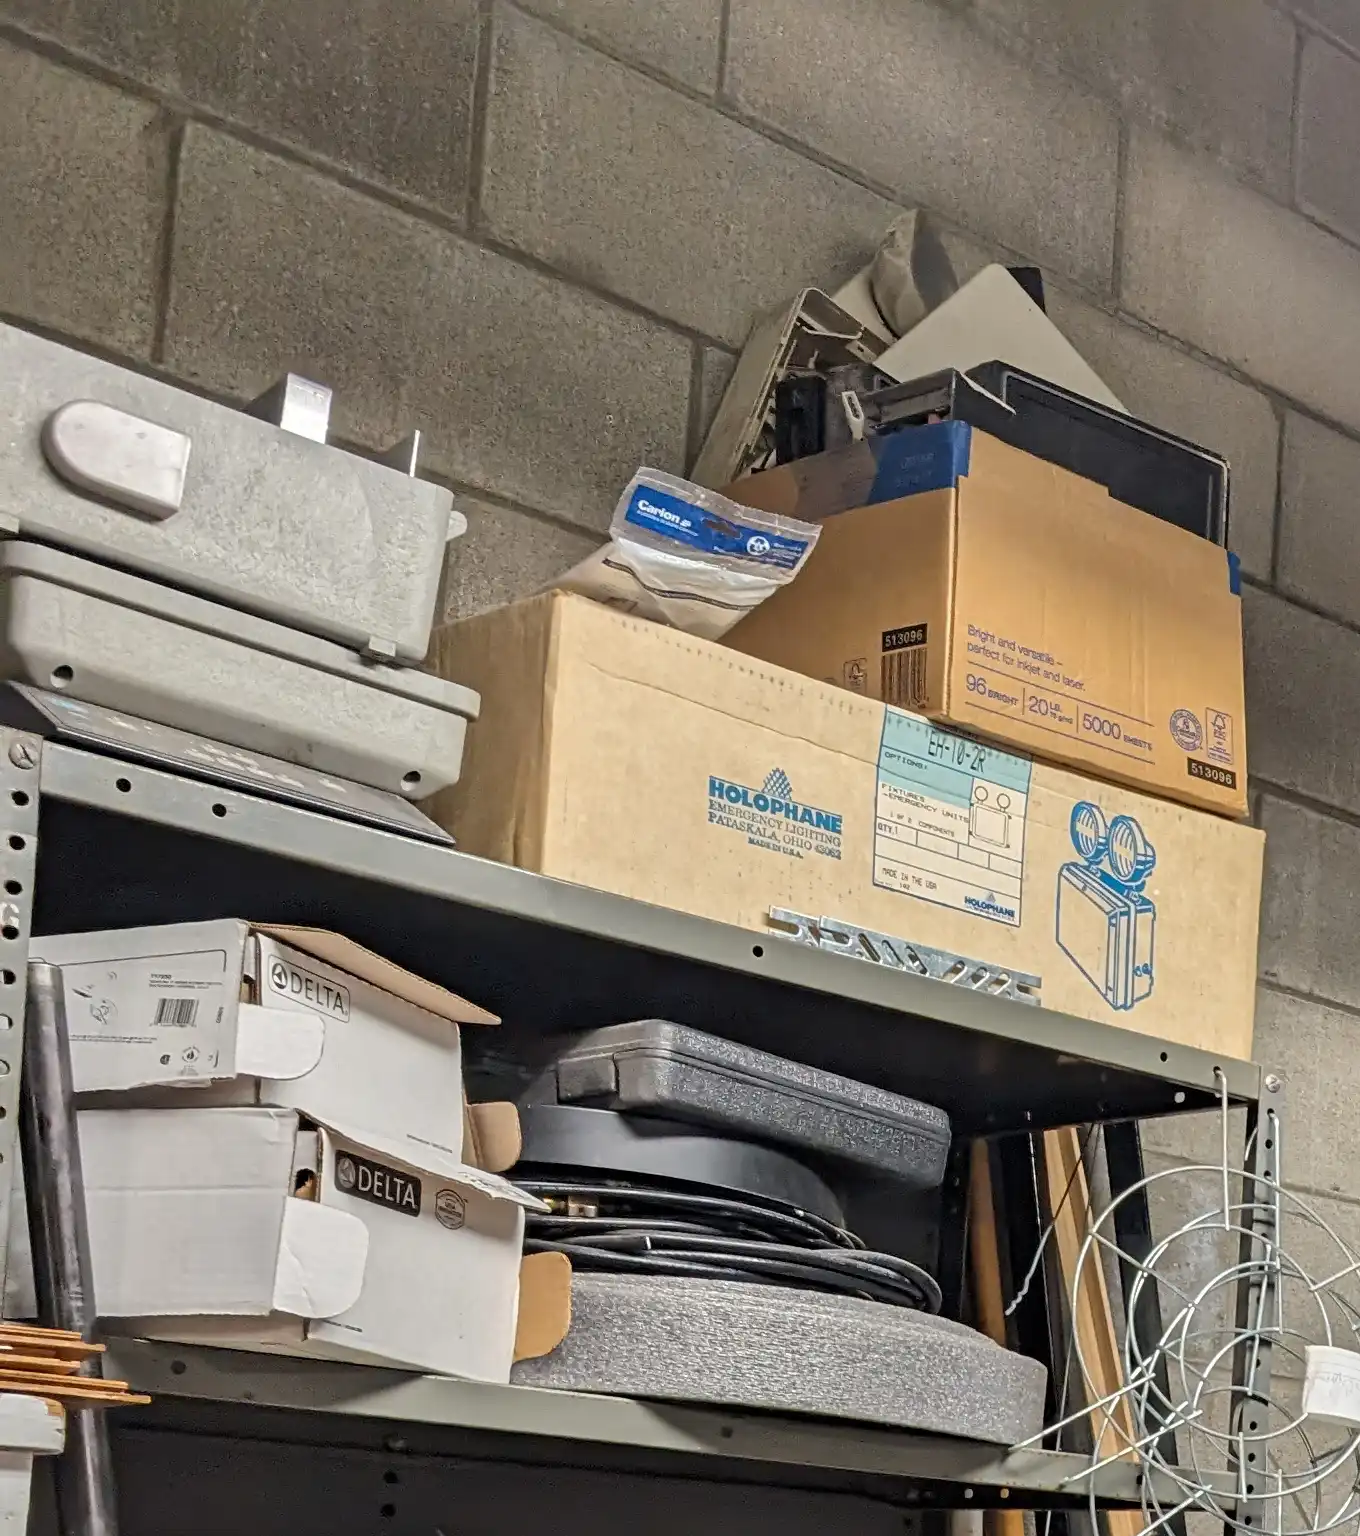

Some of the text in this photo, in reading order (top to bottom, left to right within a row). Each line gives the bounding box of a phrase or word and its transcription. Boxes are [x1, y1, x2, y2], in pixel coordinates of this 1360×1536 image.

[885, 629, 923, 648] 513096
[967, 624, 996, 644] Bright
[998, 637, 1017, 652] and
[967, 642, 1000, 661] perfect
[1002, 652, 1014, 666] for
[1043, 668, 1061, 683] and
[965, 673, 988, 696] 96
[1028, 696, 1050, 717] 20
[1082, 713, 1122, 741] 5000
[927, 730, 987, 774] EH-10-2R
[1190, 763, 1233, 785] 513096
[708, 777, 843, 836] HOLOPHANE
[708, 799, 842, 848] EMERGENCY LIGHTING
[942, 809, 970, 823] UNITS
[707, 811, 782, 844] PATASKALA,
[783, 835, 813, 851] OHIO
[289, 971, 348, 1016] DELTA
[358, 1164, 418, 1210] DELTA
